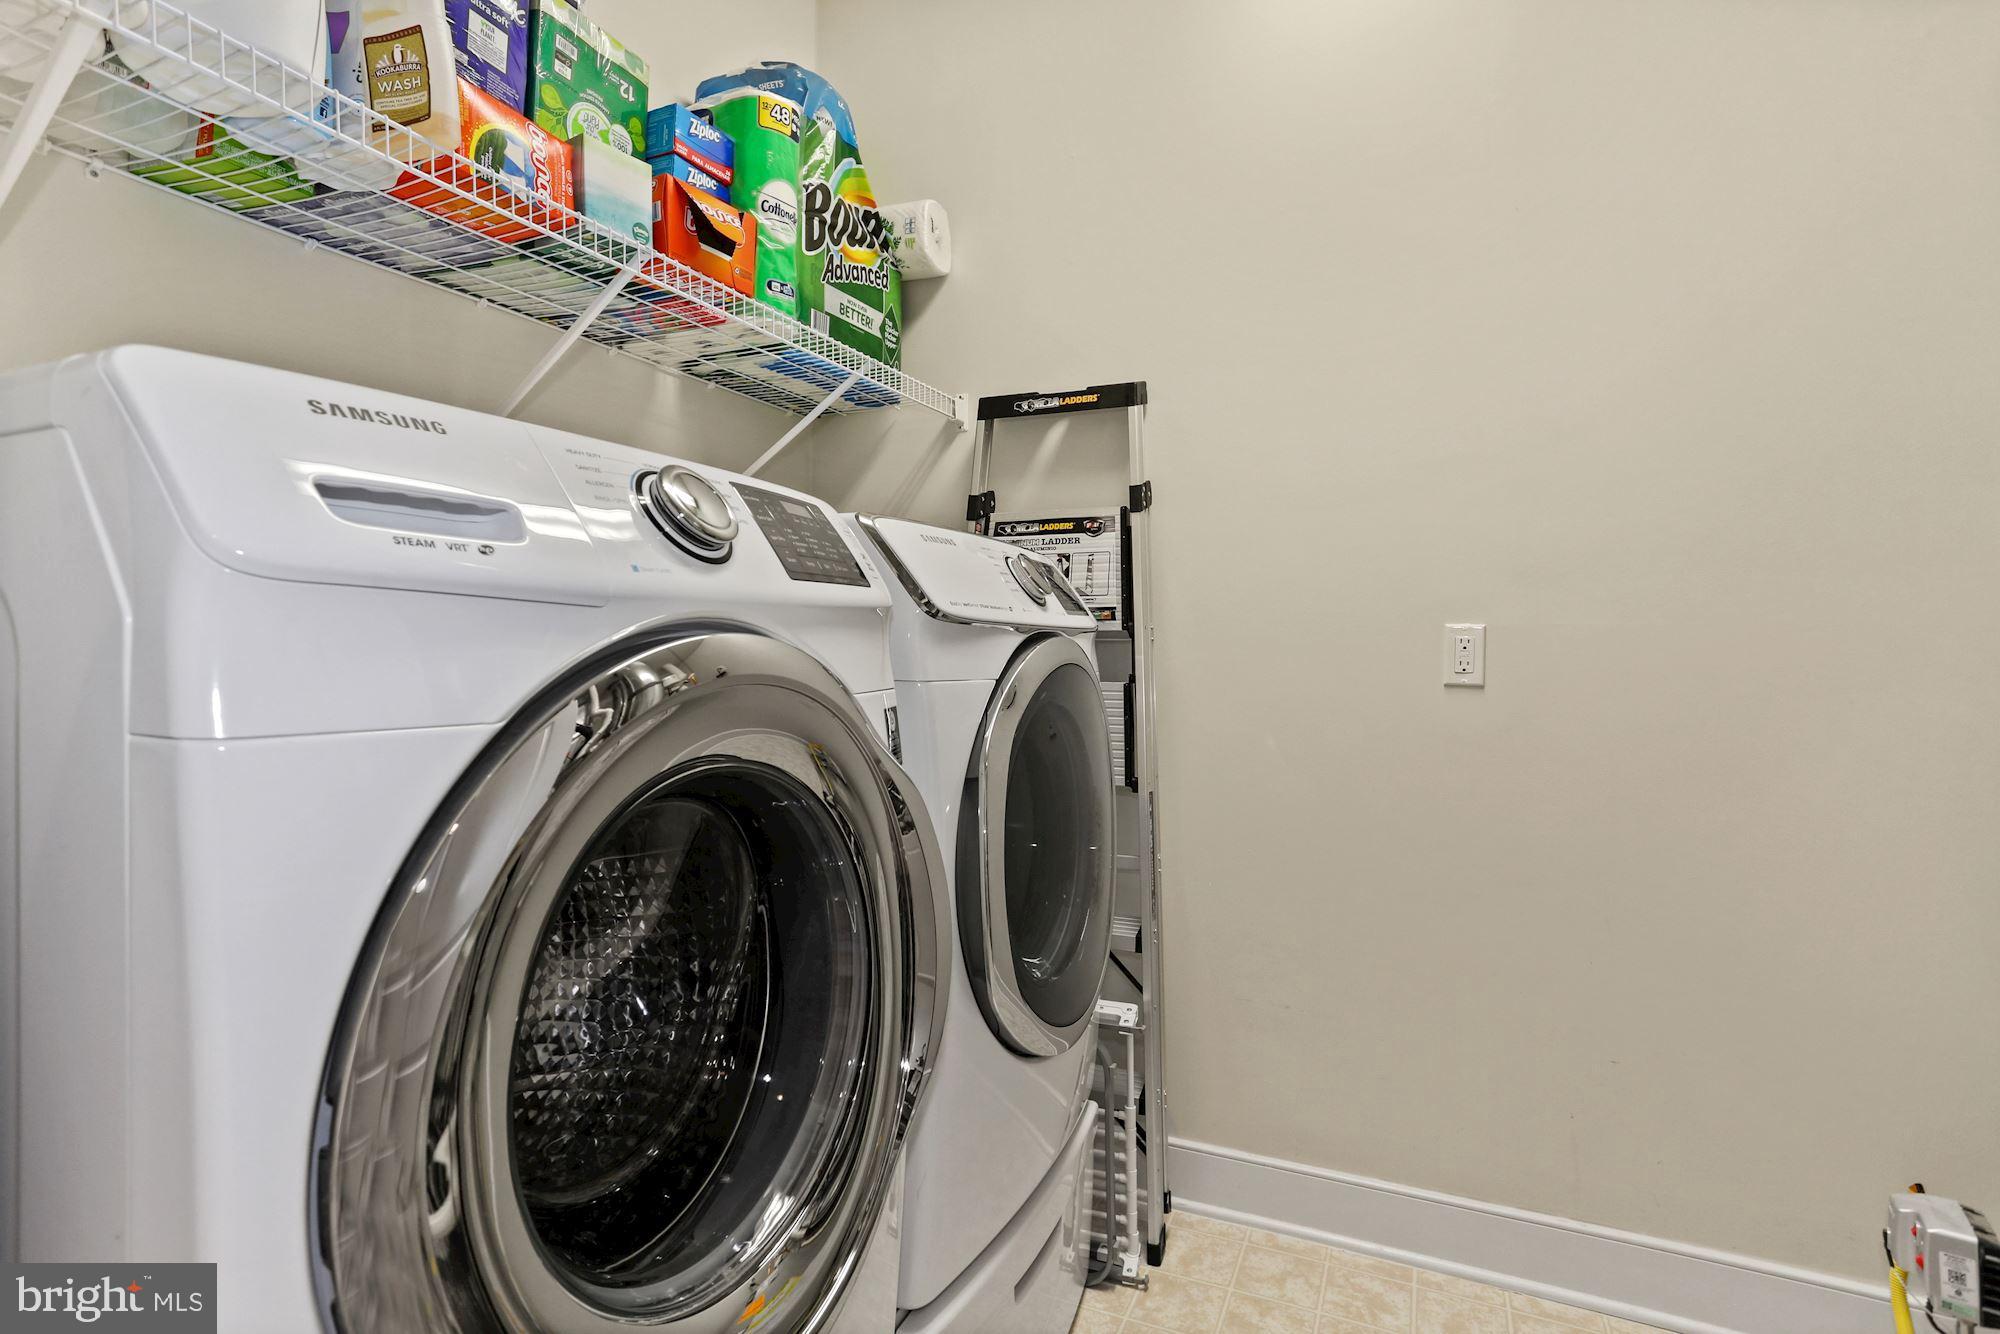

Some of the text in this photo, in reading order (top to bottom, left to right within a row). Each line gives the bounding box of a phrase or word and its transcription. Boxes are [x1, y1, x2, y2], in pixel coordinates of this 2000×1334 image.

[492, 12, 510, 28] soft
[376, 63, 421, 77] KOOKABURRA
[378, 76, 422, 92] WASH
[619, 79, 635, 103] 12
[758, 80, 784, 91] SHEETS
[770, 103, 790, 127] 48
[690, 117, 720, 142] Ziploc
[687, 167, 718, 190] Ziploc
[803, 181, 890, 256] Boun
[822, 253, 889, 290] Advanced
[839, 302, 874, 330] BETTER!
[1060, 393, 1098, 406] LADDERS
[307, 399, 447, 435] SAMSUNG
[1040, 522, 1075, 531] LADDERS
[393, 536, 436, 549] STEAM
[1041, 537, 1081, 545] LADDER
